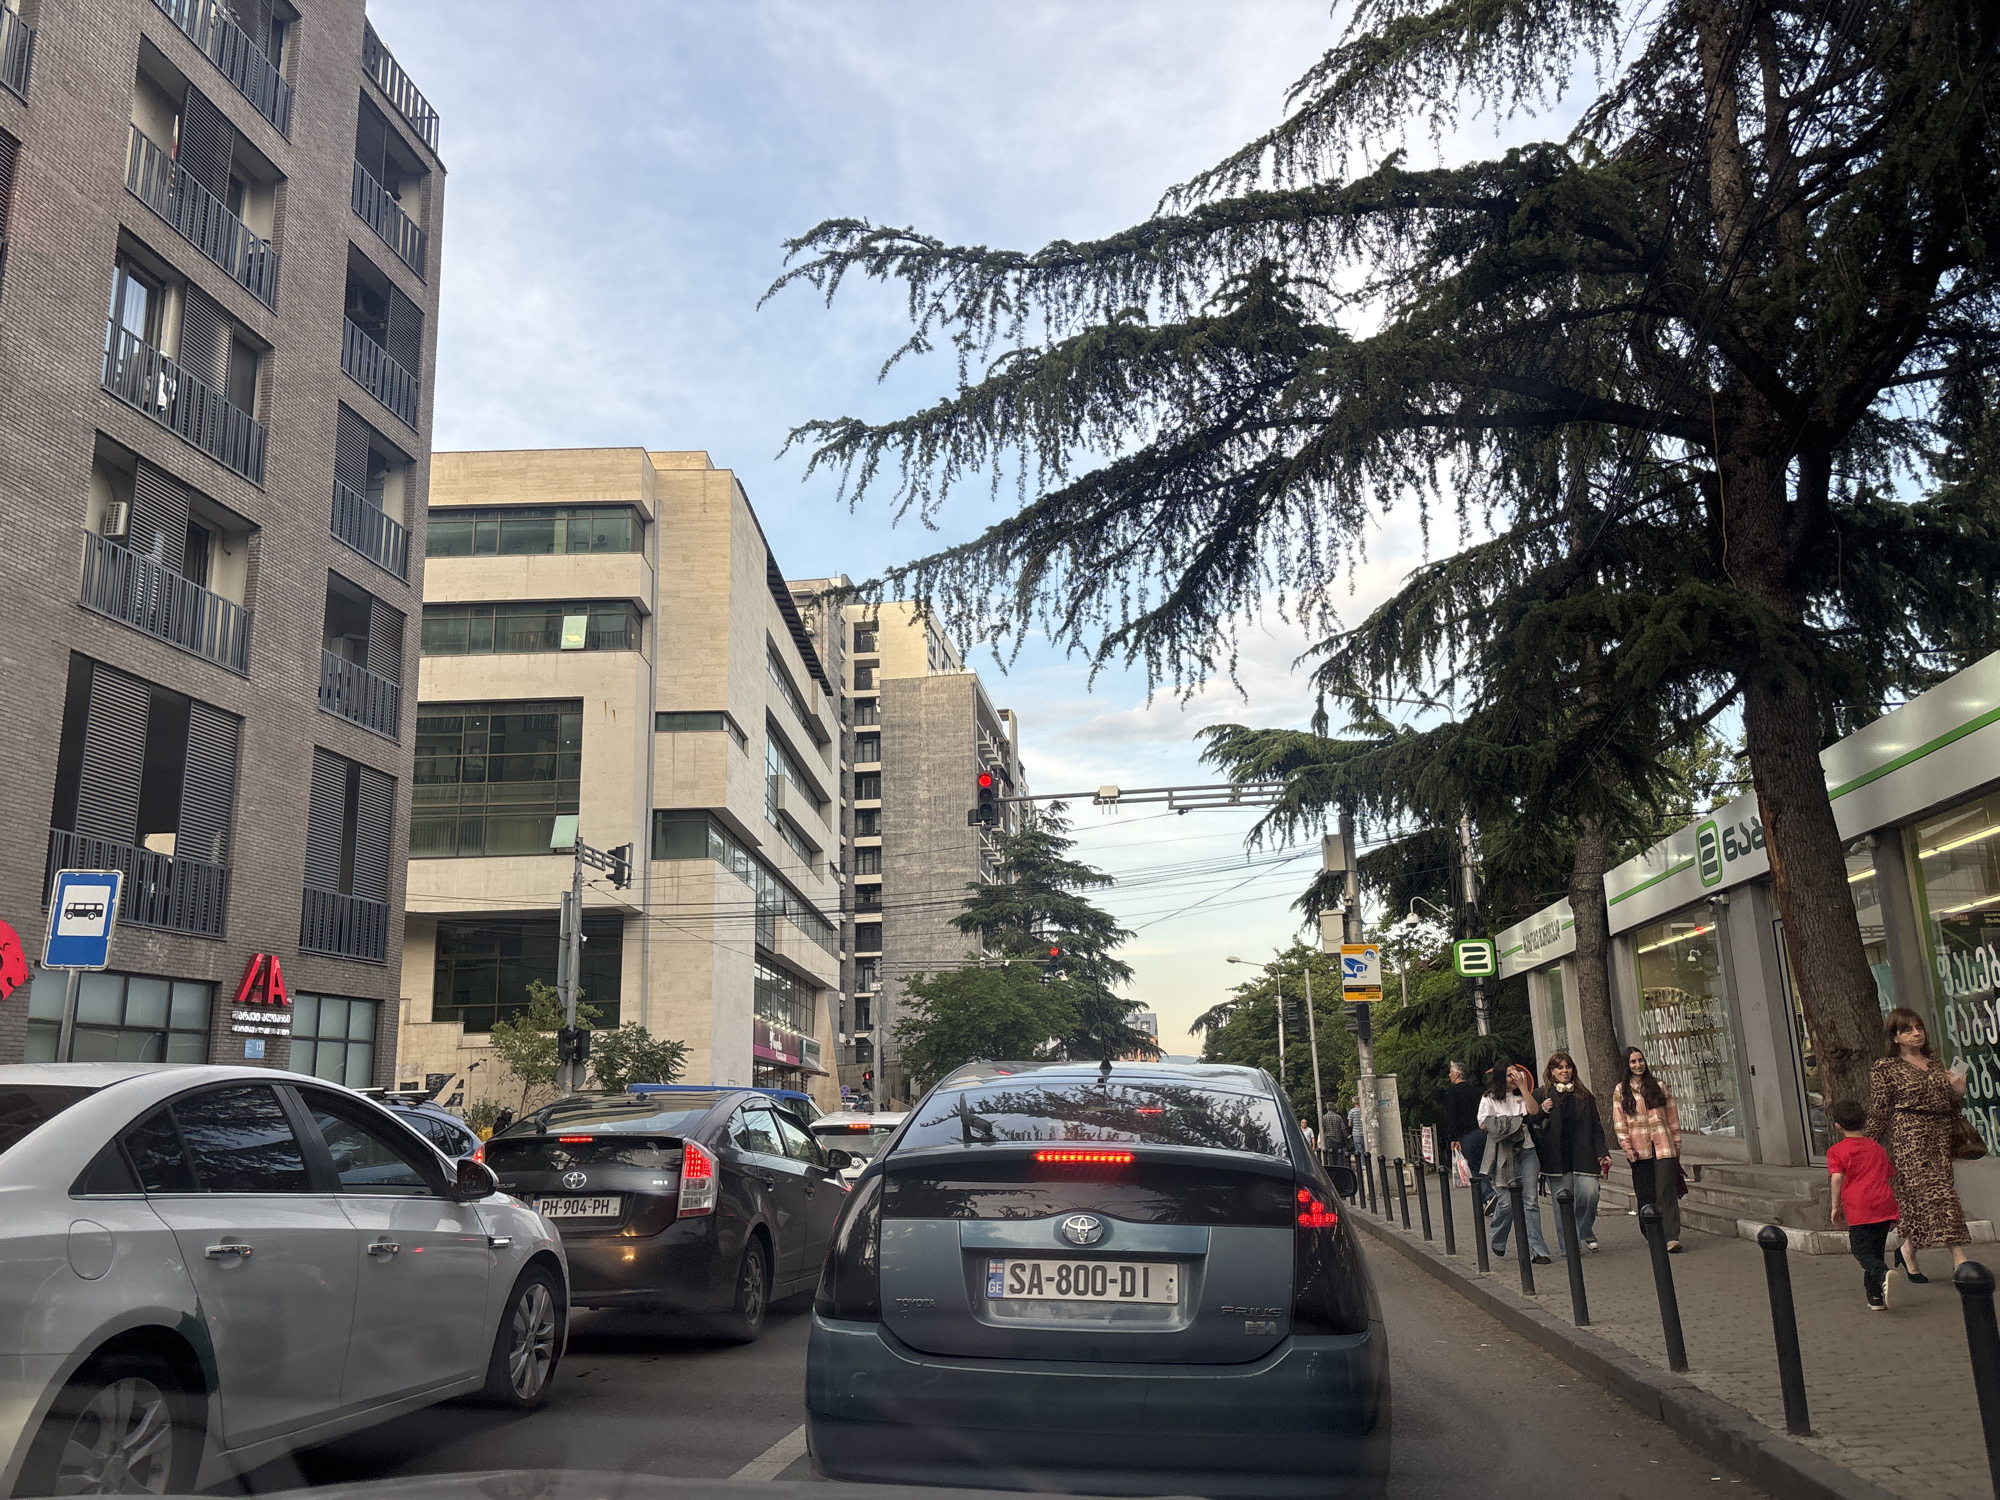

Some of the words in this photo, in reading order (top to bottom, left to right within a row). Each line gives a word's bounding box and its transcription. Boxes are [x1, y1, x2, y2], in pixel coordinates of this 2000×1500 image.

[1936, 941, 2000, 996] ფასებ
[541, 1198, 610, 1216] PH-904-PH
[988, 1281, 1003, 1294] GE
[895, 1297, 936, 1308] TOYOTA
[1220, 1305, 1284, 1317] PRIUS
